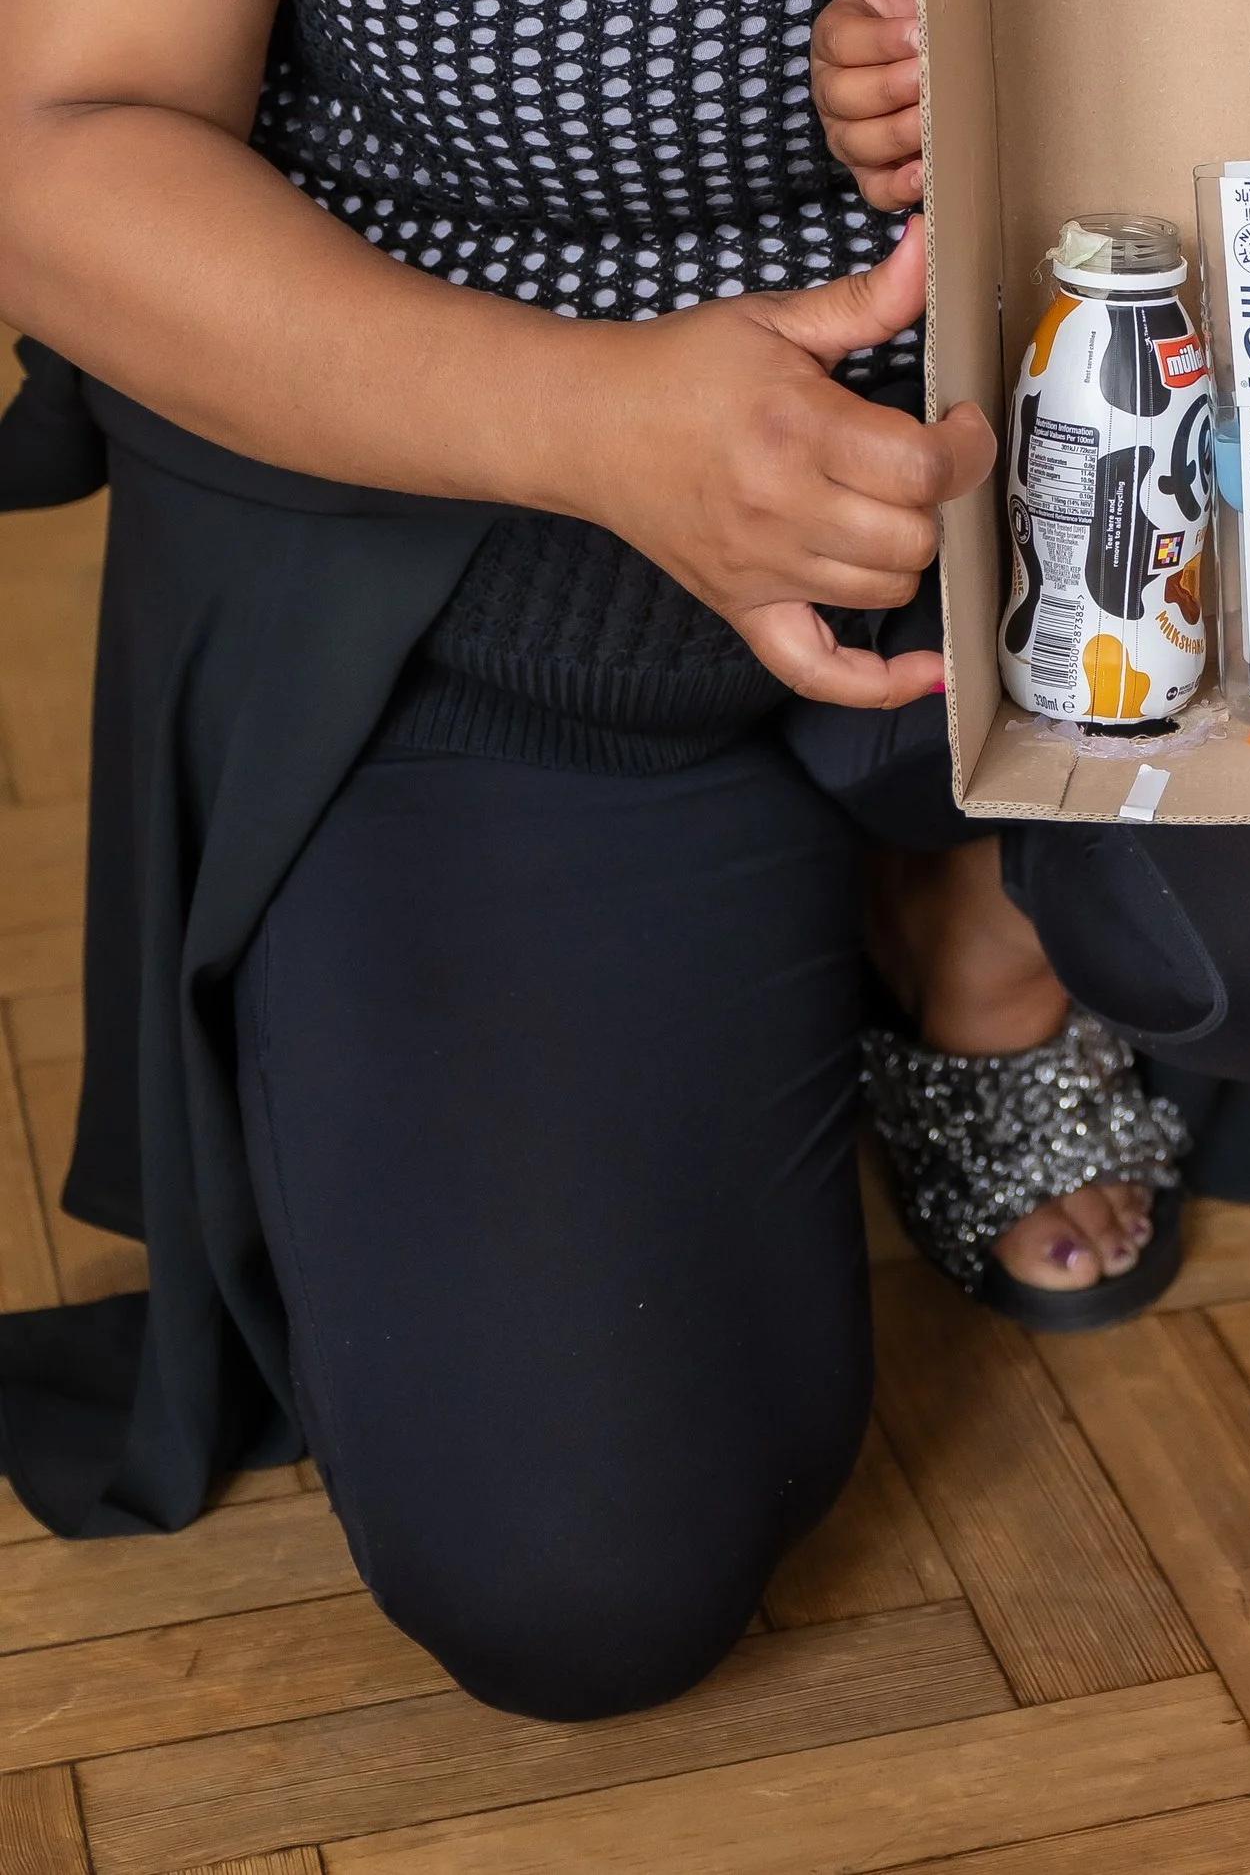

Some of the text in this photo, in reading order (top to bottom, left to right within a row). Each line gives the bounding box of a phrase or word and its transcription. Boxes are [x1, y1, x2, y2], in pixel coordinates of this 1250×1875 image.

[1058, 423, 1094, 436] Information
[1066, 434, 1076, 442] Per
[1077, 436, 1095, 444] 100ml
[1108, 499, 1116, 514] and
[1116, 481, 1126, 515] recycling
[1107, 515, 1115, 532] here
[1115, 530, 1121, 539] to
[1073, 605, 1085, 644] 287382
[1068, 648, 1080, 687] 025500
[1034, 693, 1059, 711] 330ml
